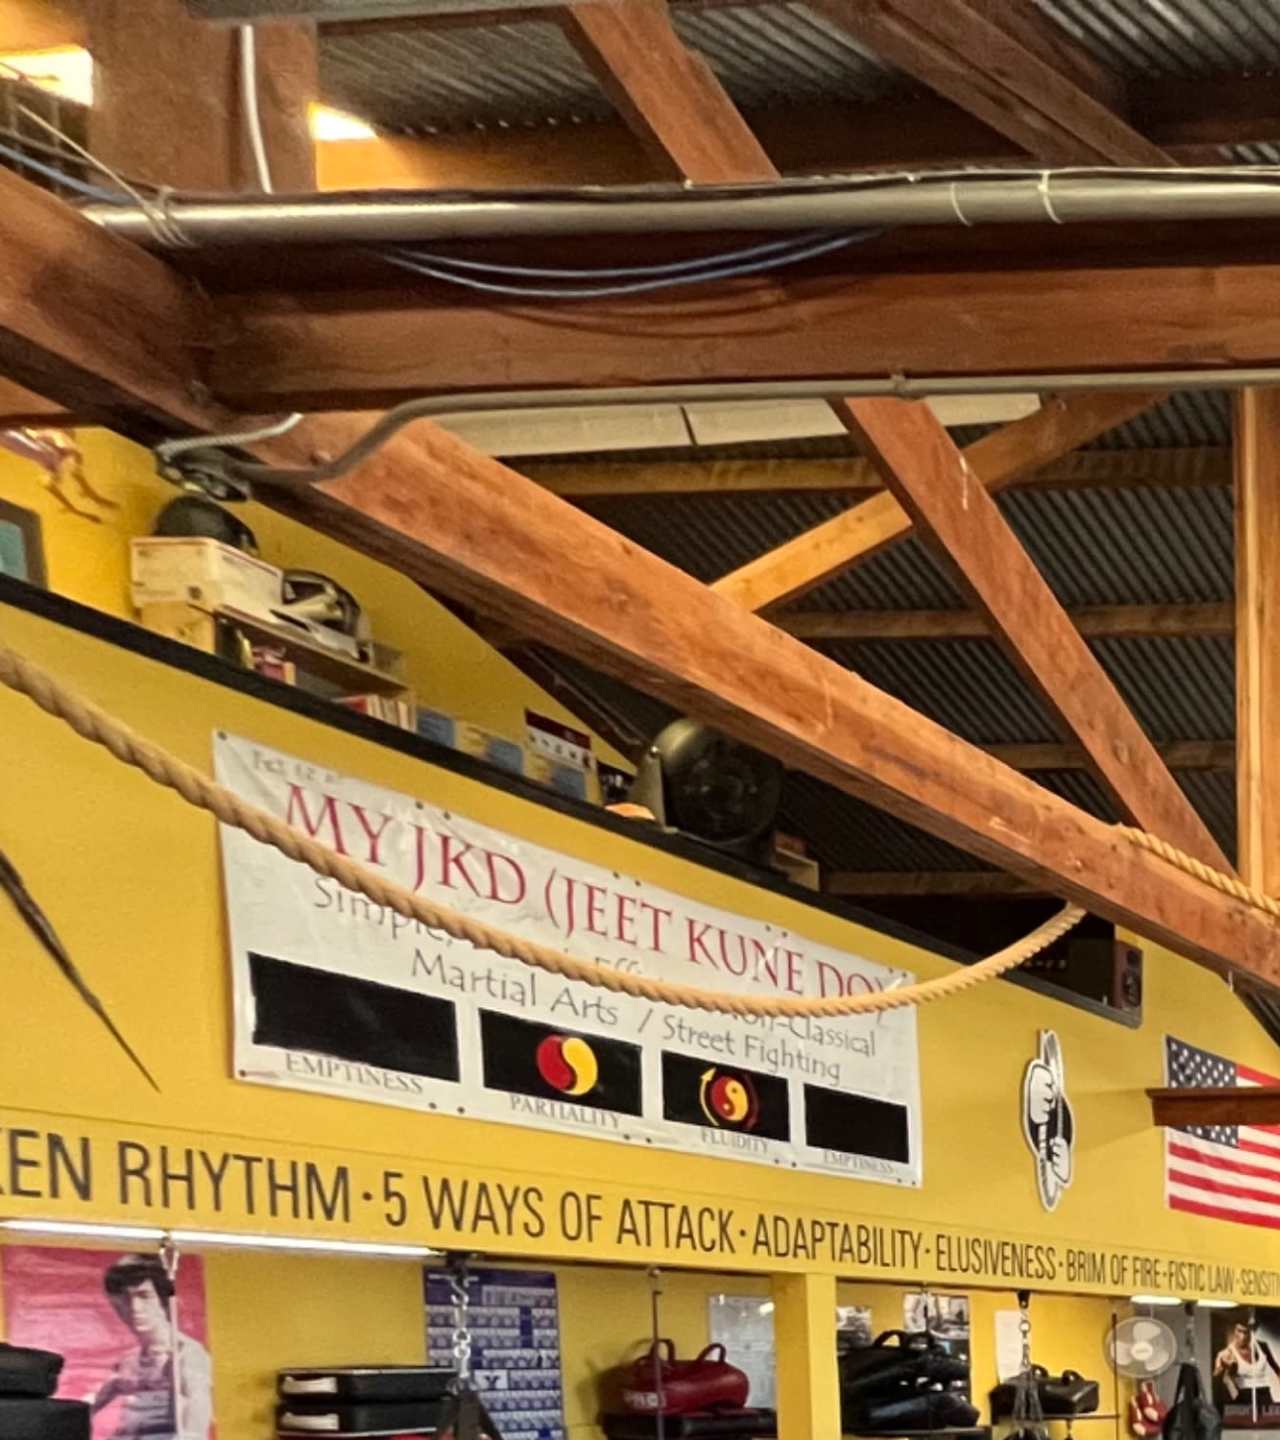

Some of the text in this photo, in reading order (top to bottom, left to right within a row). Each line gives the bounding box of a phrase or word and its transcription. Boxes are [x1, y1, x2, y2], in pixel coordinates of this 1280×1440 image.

[286, 782, 393, 866] MY
[412, 823, 527, 904] JKD
[545, 866, 671, 952] (JEET
[686, 917, 802, 996] KUNE
[412, 949, 537, 1006] Martial
[550, 986, 618, 1026] Arts
[662, 1014, 735, 1053] Street
[744, 1032, 841, 1086] Fighting
[286, 1052, 423, 1096] EMPTINESS
[510, 1094, 620, 1130] PARTIALITY
[701, 1129, 768, 1155] FLUIDITY
[0, 1129, 91, 1202] EN
[118, 1140, 351, 1223] RHYTHM
[383, 1171, 407, 1229] 5
[422, 1174, 545, 1239] WAYS
[560, 1191, 602, 1243] OF
[616, 1198, 736, 1254] ATTACK
[752, 1214, 922, 1271] ADAPTABILITY
[936, 1234, 1056, 1281] ELUSIVENESS
[1066, 1249, 1106, 1285] BRIM
[1110, 1254, 1128, 1286] OF
[1132, 1256, 1161, 1289] FIRE
[1168, 1260, 1205, 1292] FISTIC
[1208, 1264, 1236, 1294] LAW
